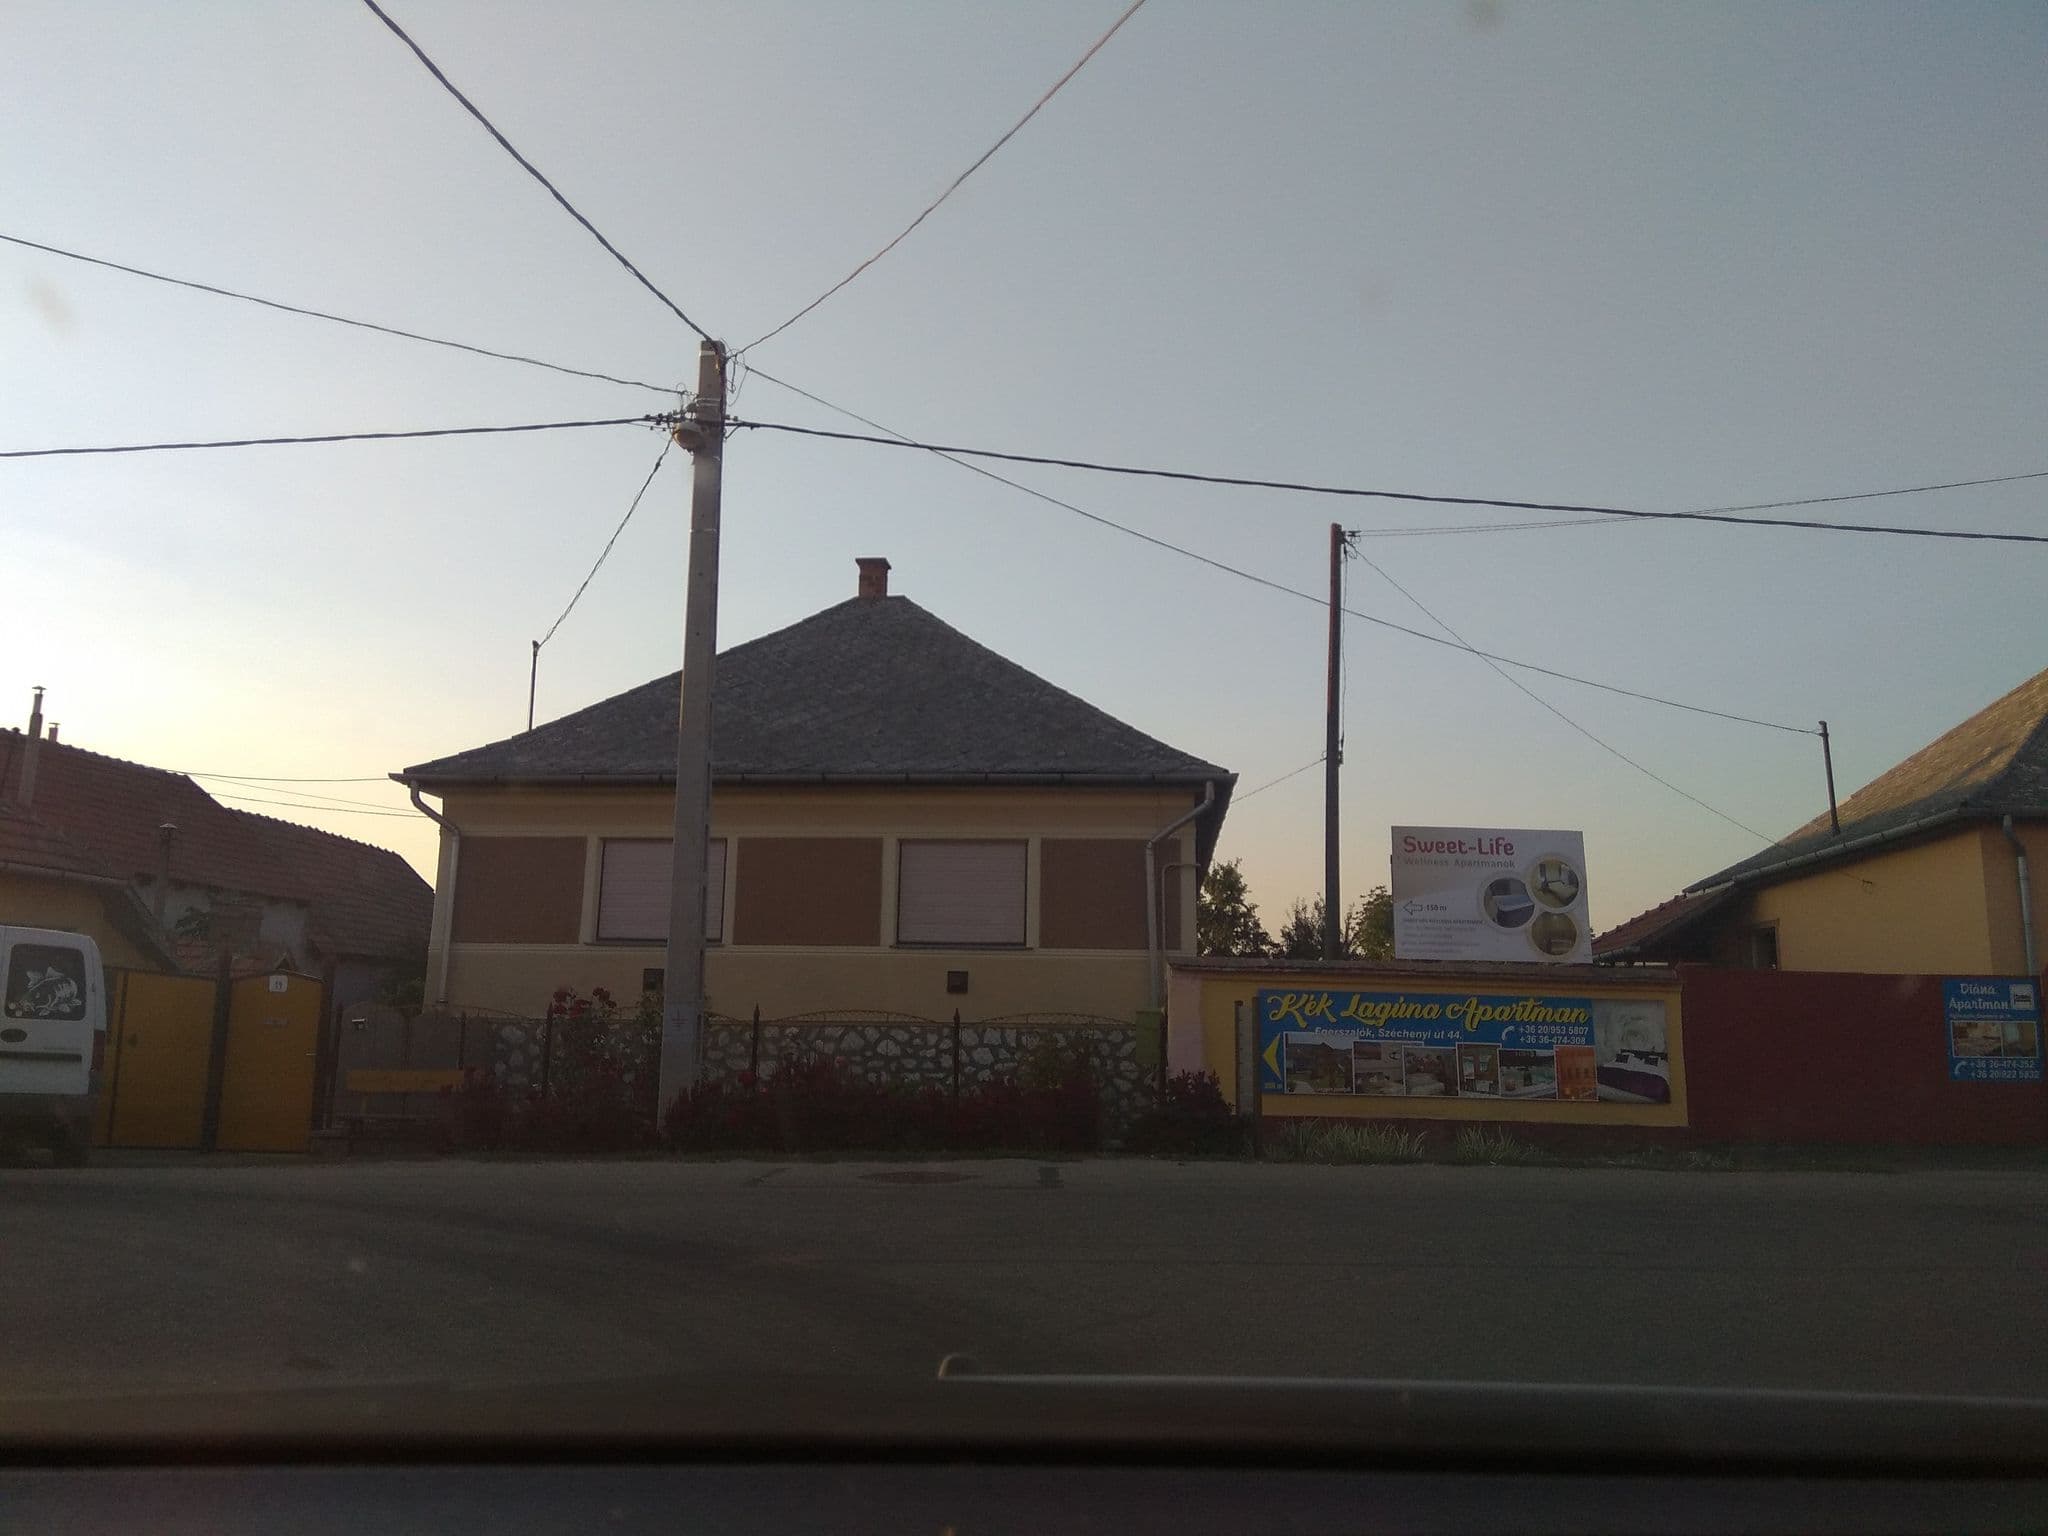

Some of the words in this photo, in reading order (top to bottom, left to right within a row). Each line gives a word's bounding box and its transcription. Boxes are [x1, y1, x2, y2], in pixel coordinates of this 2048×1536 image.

[1403, 835, 1515, 856] Sweet-Life
[1948, 997, 2009, 1011] Apartman
[1267, 991, 1337, 1028] Kék
[1340, 994, 1442, 1027] Lagúna
[1446, 997, 1591, 1032] Apartman
[1378, 1028, 1432, 1040] Széchenyi
[1447, 1030, 1463, 1040] 44.
[1519, 1025, 1536, 1034] +36
[1568, 1026, 1589, 1035] 5807
[1519, 1035, 1536, 1044] +36
[1538, 1035, 1586, 1044] 36-474-308
